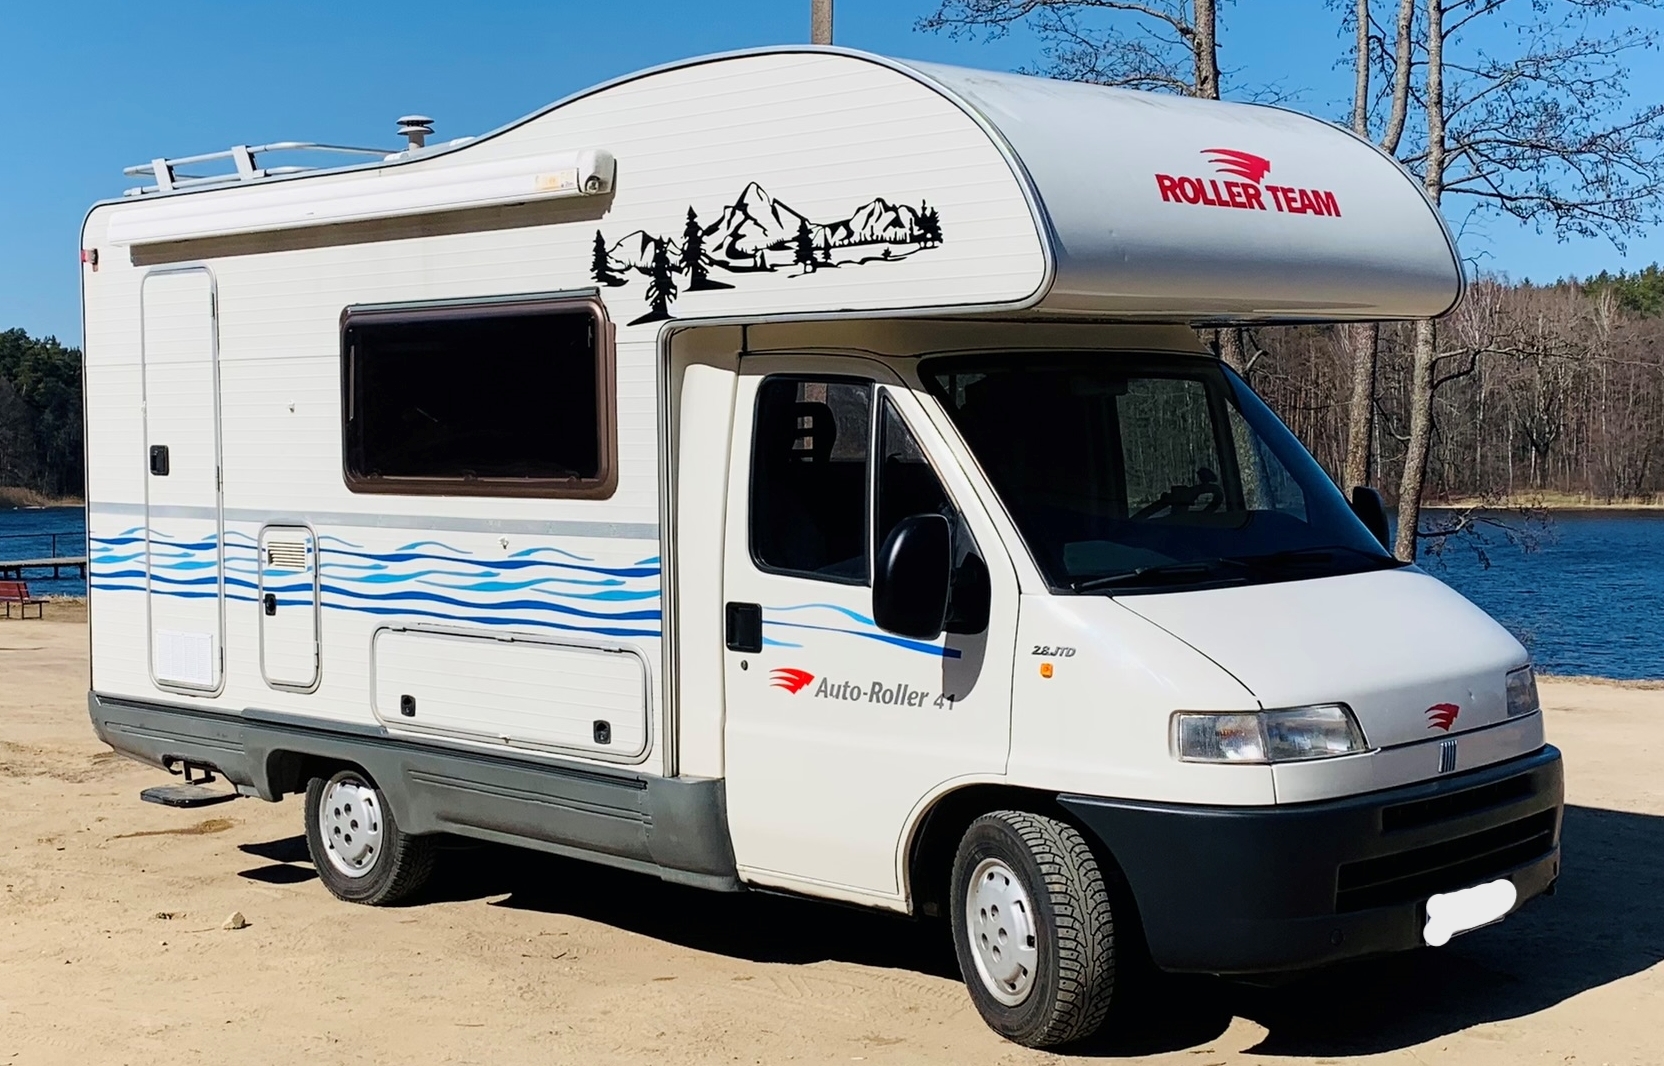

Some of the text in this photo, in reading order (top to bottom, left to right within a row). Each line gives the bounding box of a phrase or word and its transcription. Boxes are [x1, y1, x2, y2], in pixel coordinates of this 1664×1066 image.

[1155, 174, 1342, 217] ROLLER TEAM
[814, 677, 956, 710] Auto-Roller 41
